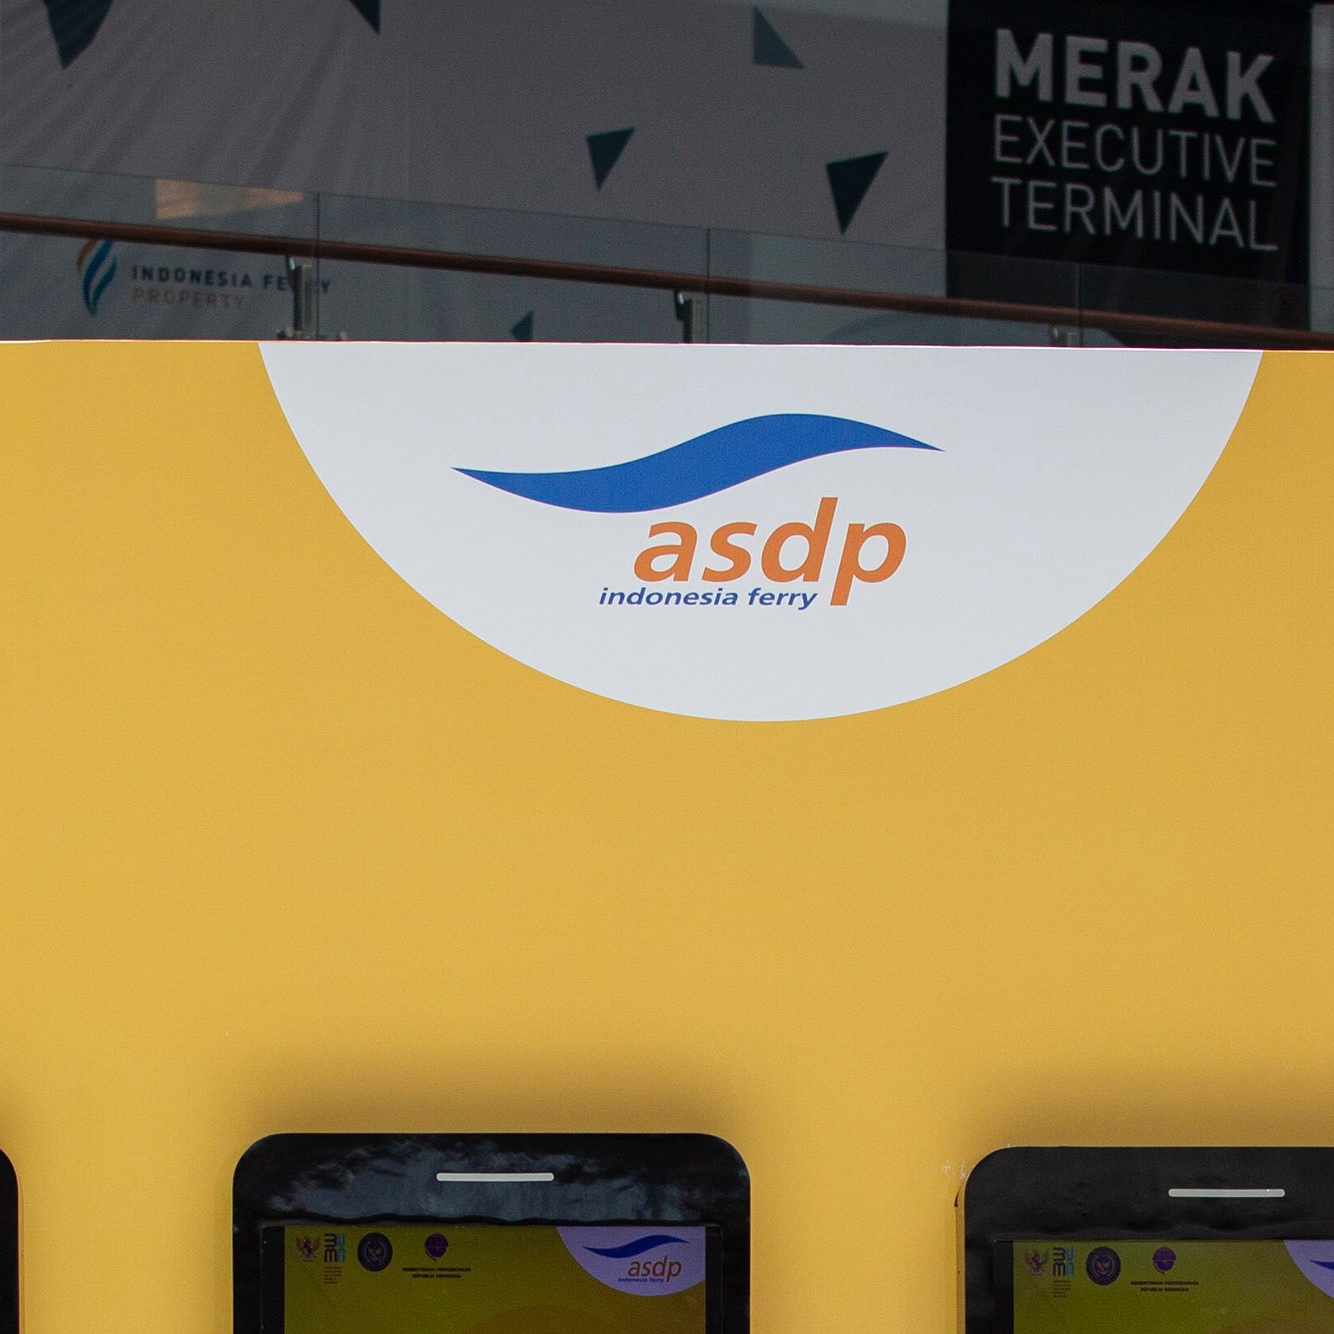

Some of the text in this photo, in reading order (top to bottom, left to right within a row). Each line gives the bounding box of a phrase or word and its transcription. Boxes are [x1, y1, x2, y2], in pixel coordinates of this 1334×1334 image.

[995, 28, 1276, 124] MERAK
[993, 114, 1278, 188] EXECUTIVE
[991, 176, 1279, 252] TERMINAL
[132, 265, 331, 294] INDONESIA FEY
[132, 287, 244, 309] PROPERTY
[633, 496, 908, 607] asdp
[598, 587, 818, 611] indonesia ferry
[628, 1254, 683, 1283] asdp
